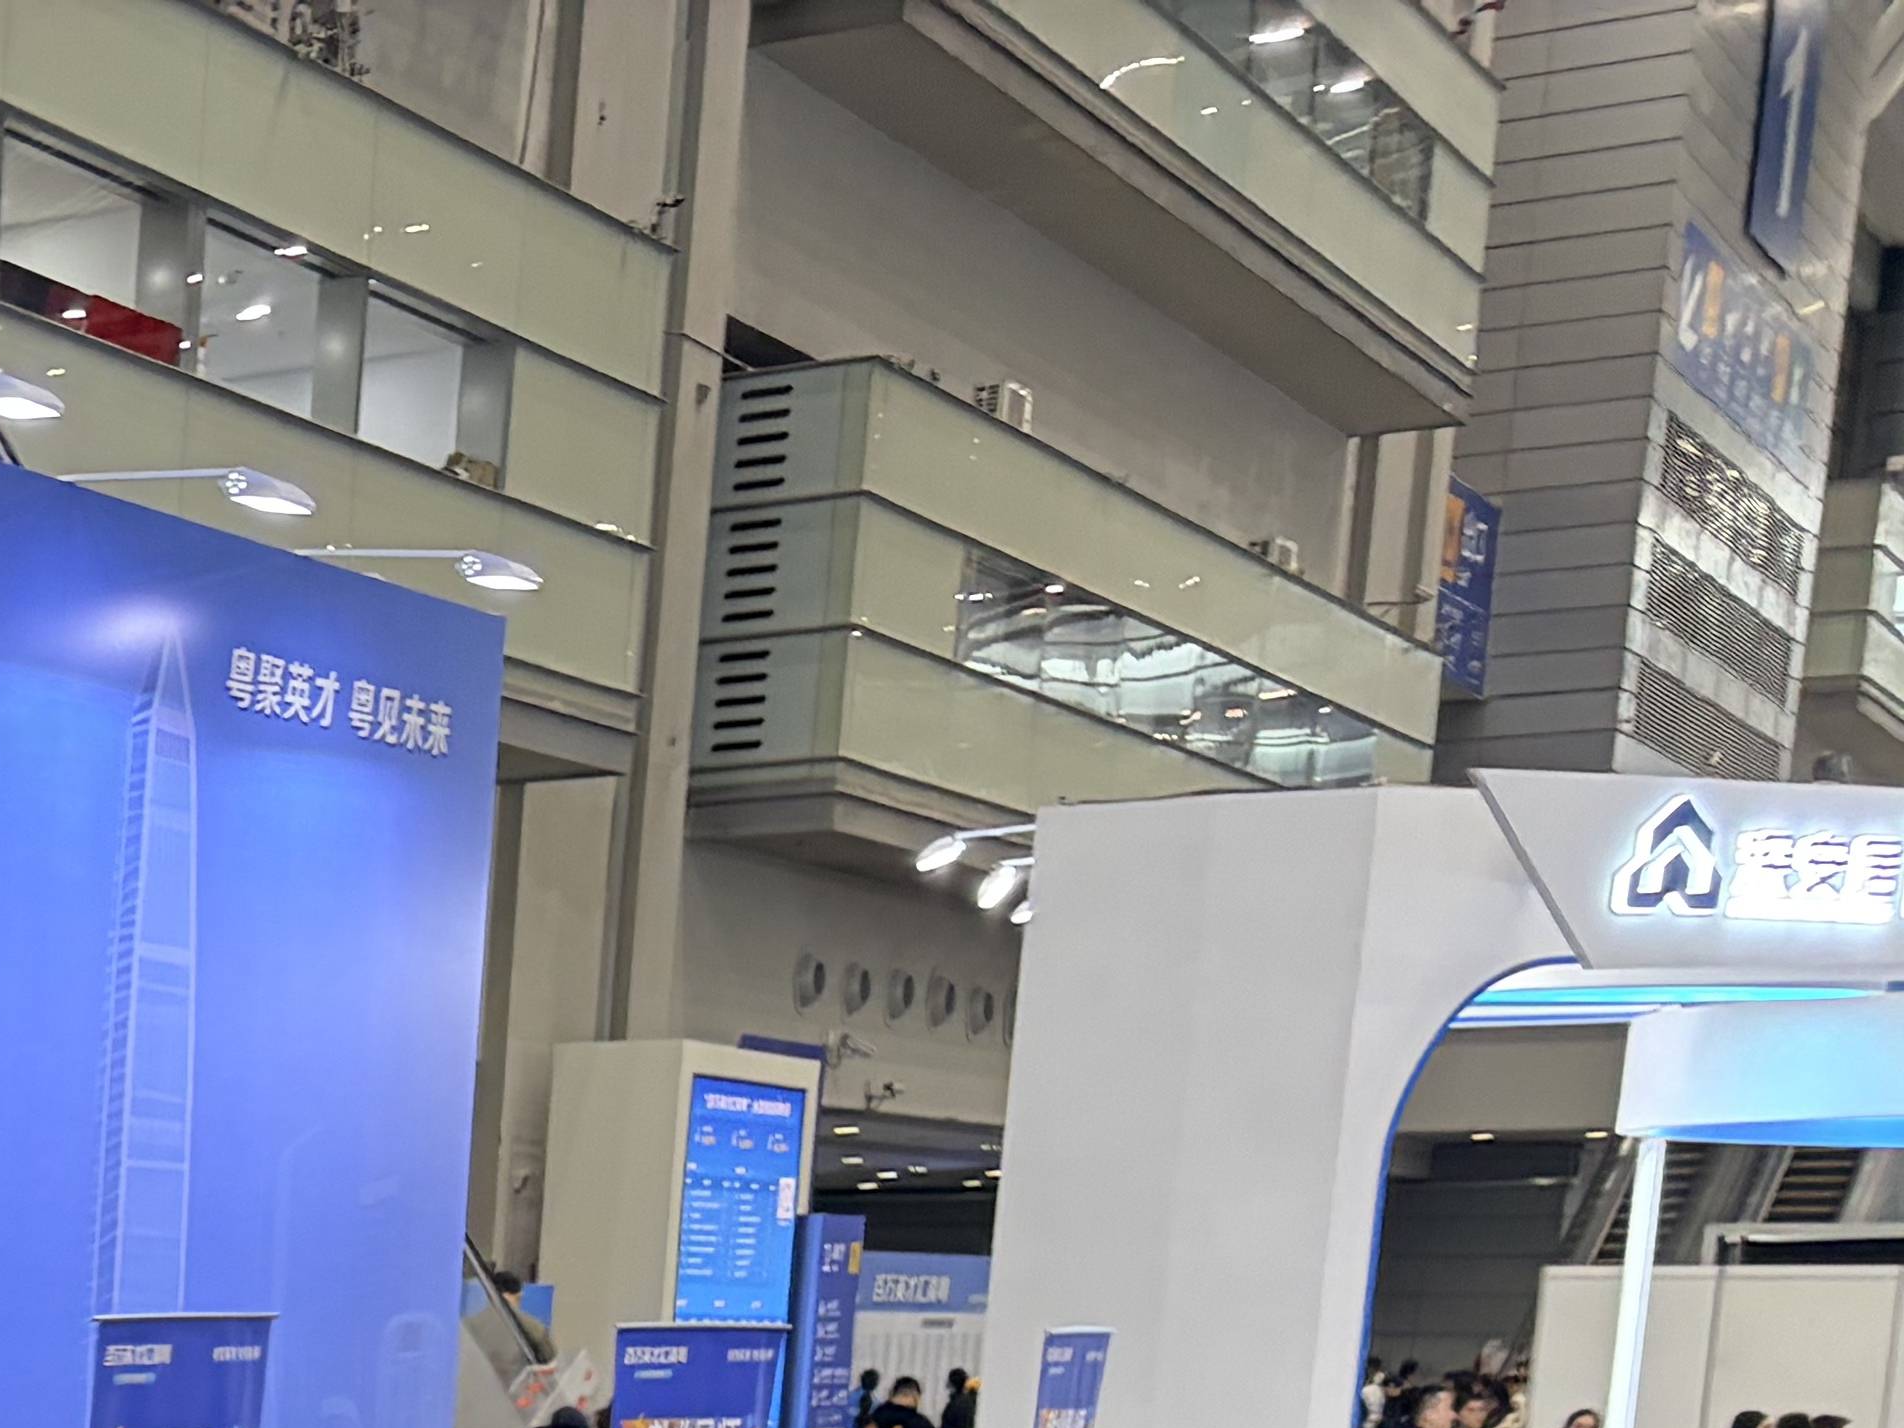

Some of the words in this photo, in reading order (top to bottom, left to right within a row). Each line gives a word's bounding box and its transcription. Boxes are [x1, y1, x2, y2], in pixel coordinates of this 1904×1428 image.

[225, 647, 341, 727] 粤聚英才
[348, 680, 453, 756] 粤见未来
